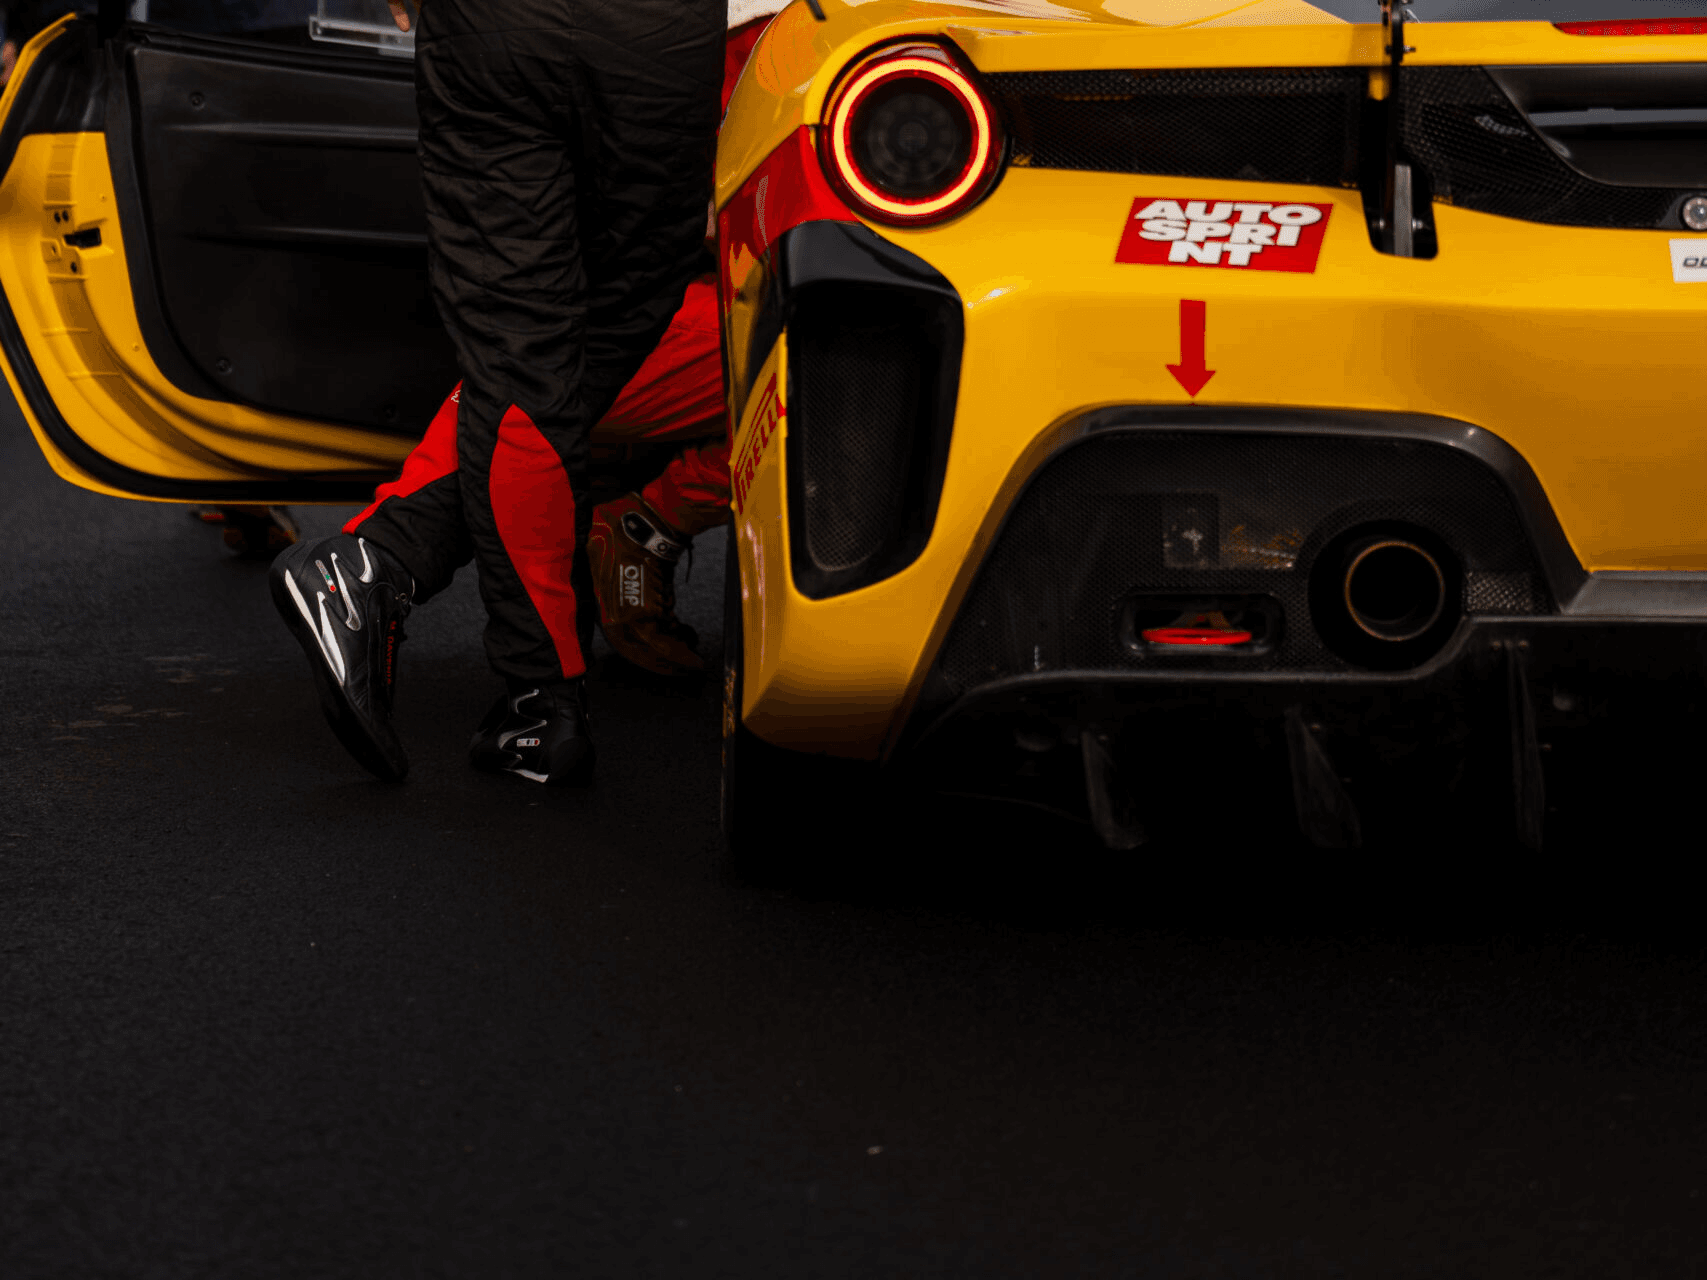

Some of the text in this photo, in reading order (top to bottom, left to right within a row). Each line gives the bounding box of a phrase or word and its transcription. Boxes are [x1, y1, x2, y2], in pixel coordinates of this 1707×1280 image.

[1134, 200, 1323, 226] AUTO
[1138, 219, 1301, 247] SPRI
[1168, 240, 1263, 266] NT
[734, 373, 787, 515] PIRELLI
[624, 565, 640, 607] OMP
